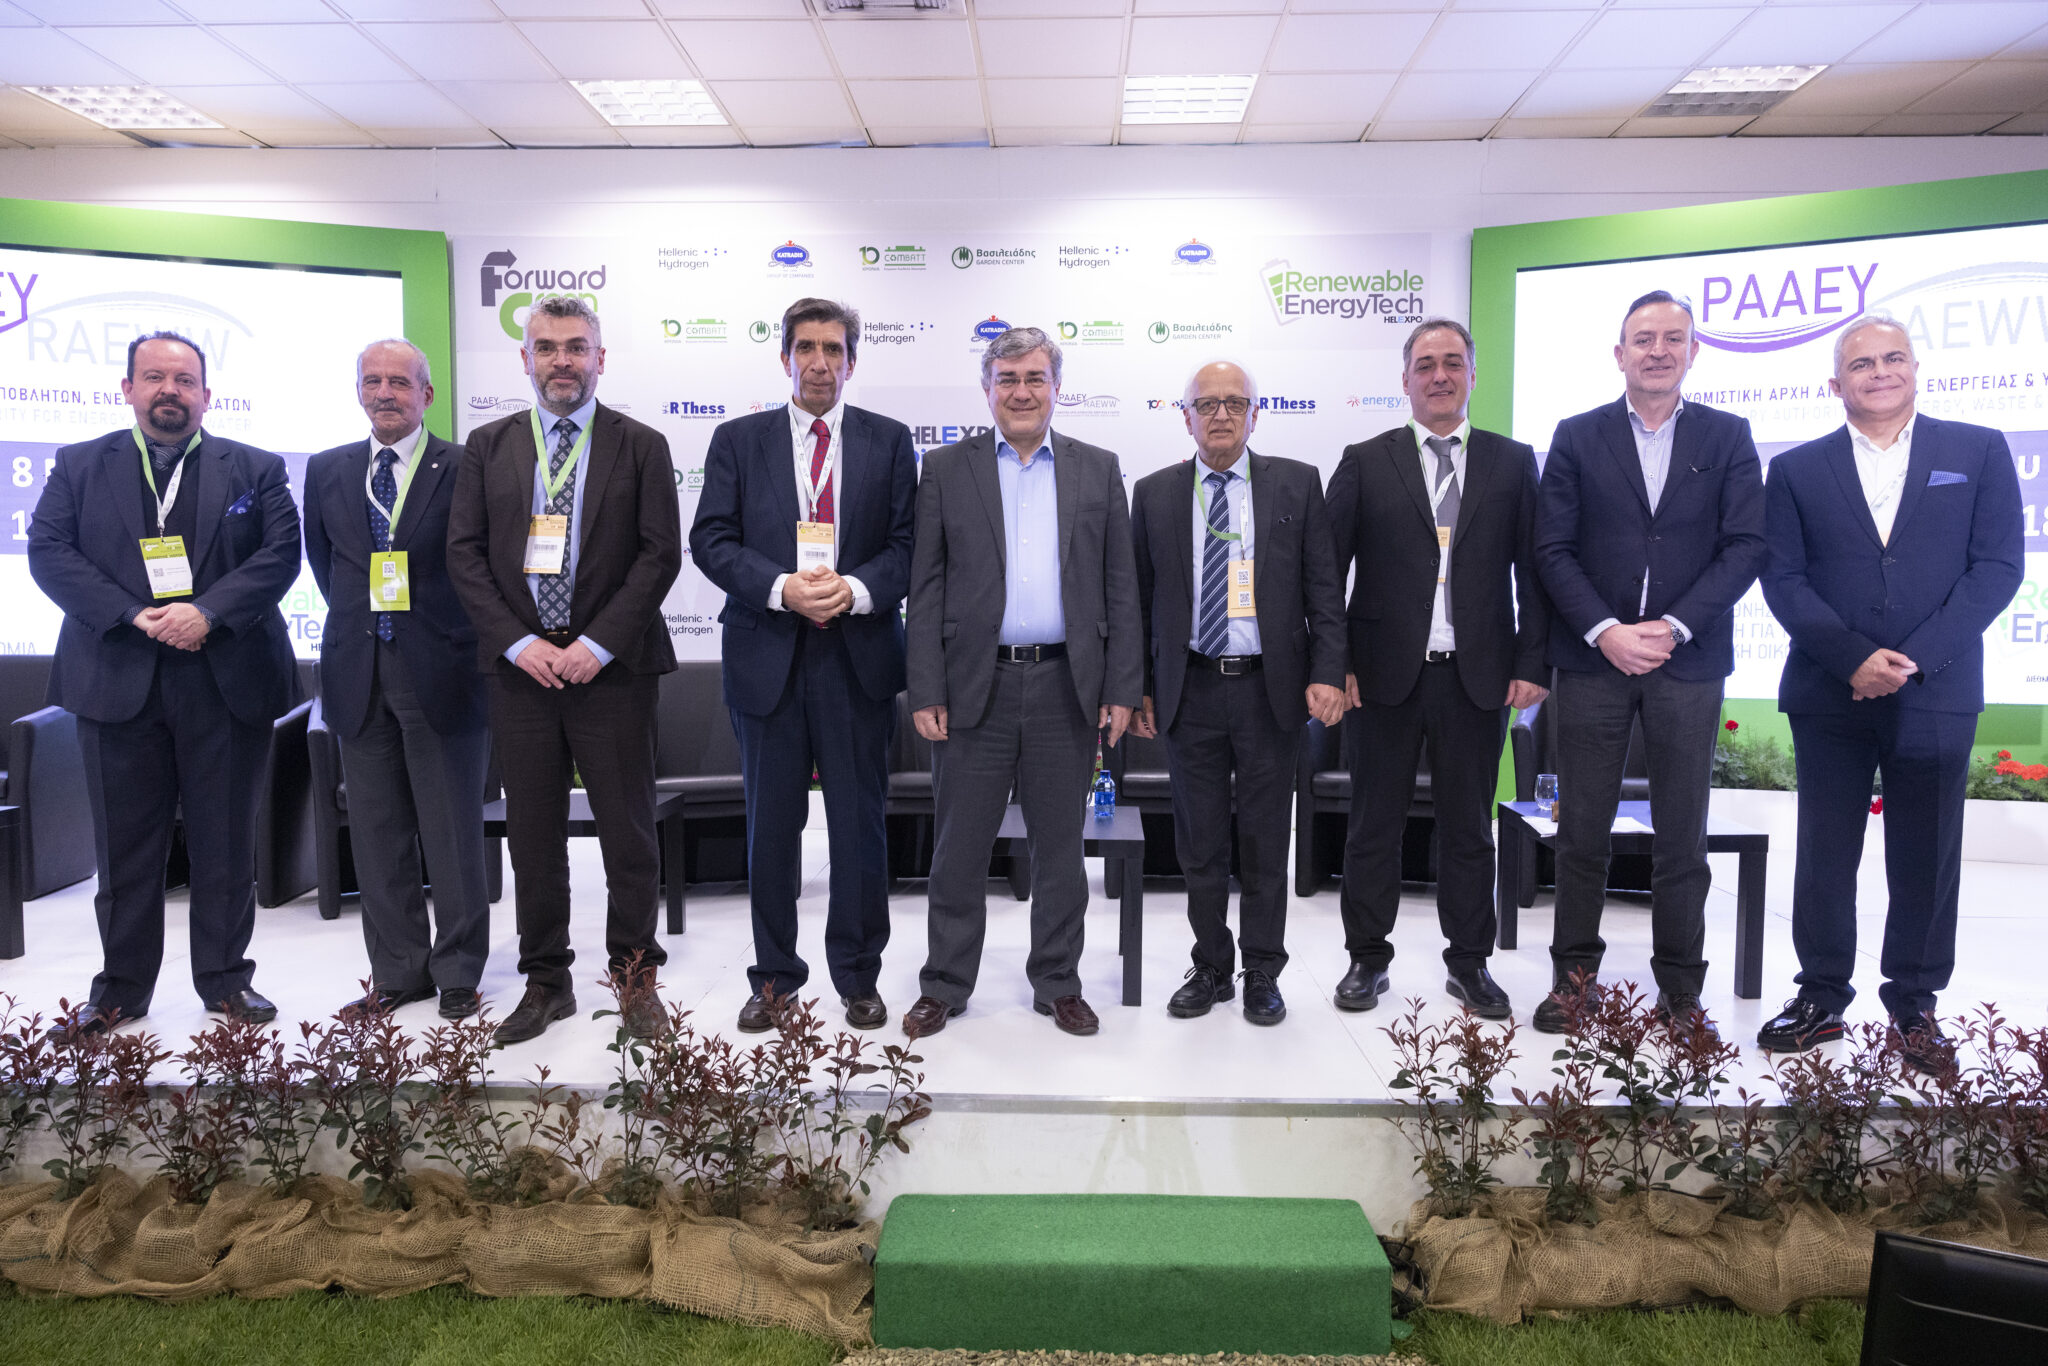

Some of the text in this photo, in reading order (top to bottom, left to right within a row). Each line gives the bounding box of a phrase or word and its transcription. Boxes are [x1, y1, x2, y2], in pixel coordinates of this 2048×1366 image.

[659, 248, 698, 257] Hellenic
[976, 249, 1036, 259] Βασιλειάδης
[1059, 246, 1099, 255] Hellenic
[659, 259, 709, 270] Hydrogen
[1059, 258, 1110, 268] Hydrogen
[1285, 269, 1425, 293] Renewable
[1284, 292, 1424, 319] EnergyTech
[1384, 316, 1423, 324] HELEXPO
[864, 322, 905, 331] Hellenic
[1172, 323, 1233, 333] Βασιλειάδης
[864, 334, 915, 344] Hydrogen
[2024, 372, 2035, 388] &
[1769, 385, 1809, 401] ΑΡΧΗ
[681, 401, 726, 414] Thess
[1271, 397, 1316, 409] Thess
[663, 614, 702, 623] Hellenic
